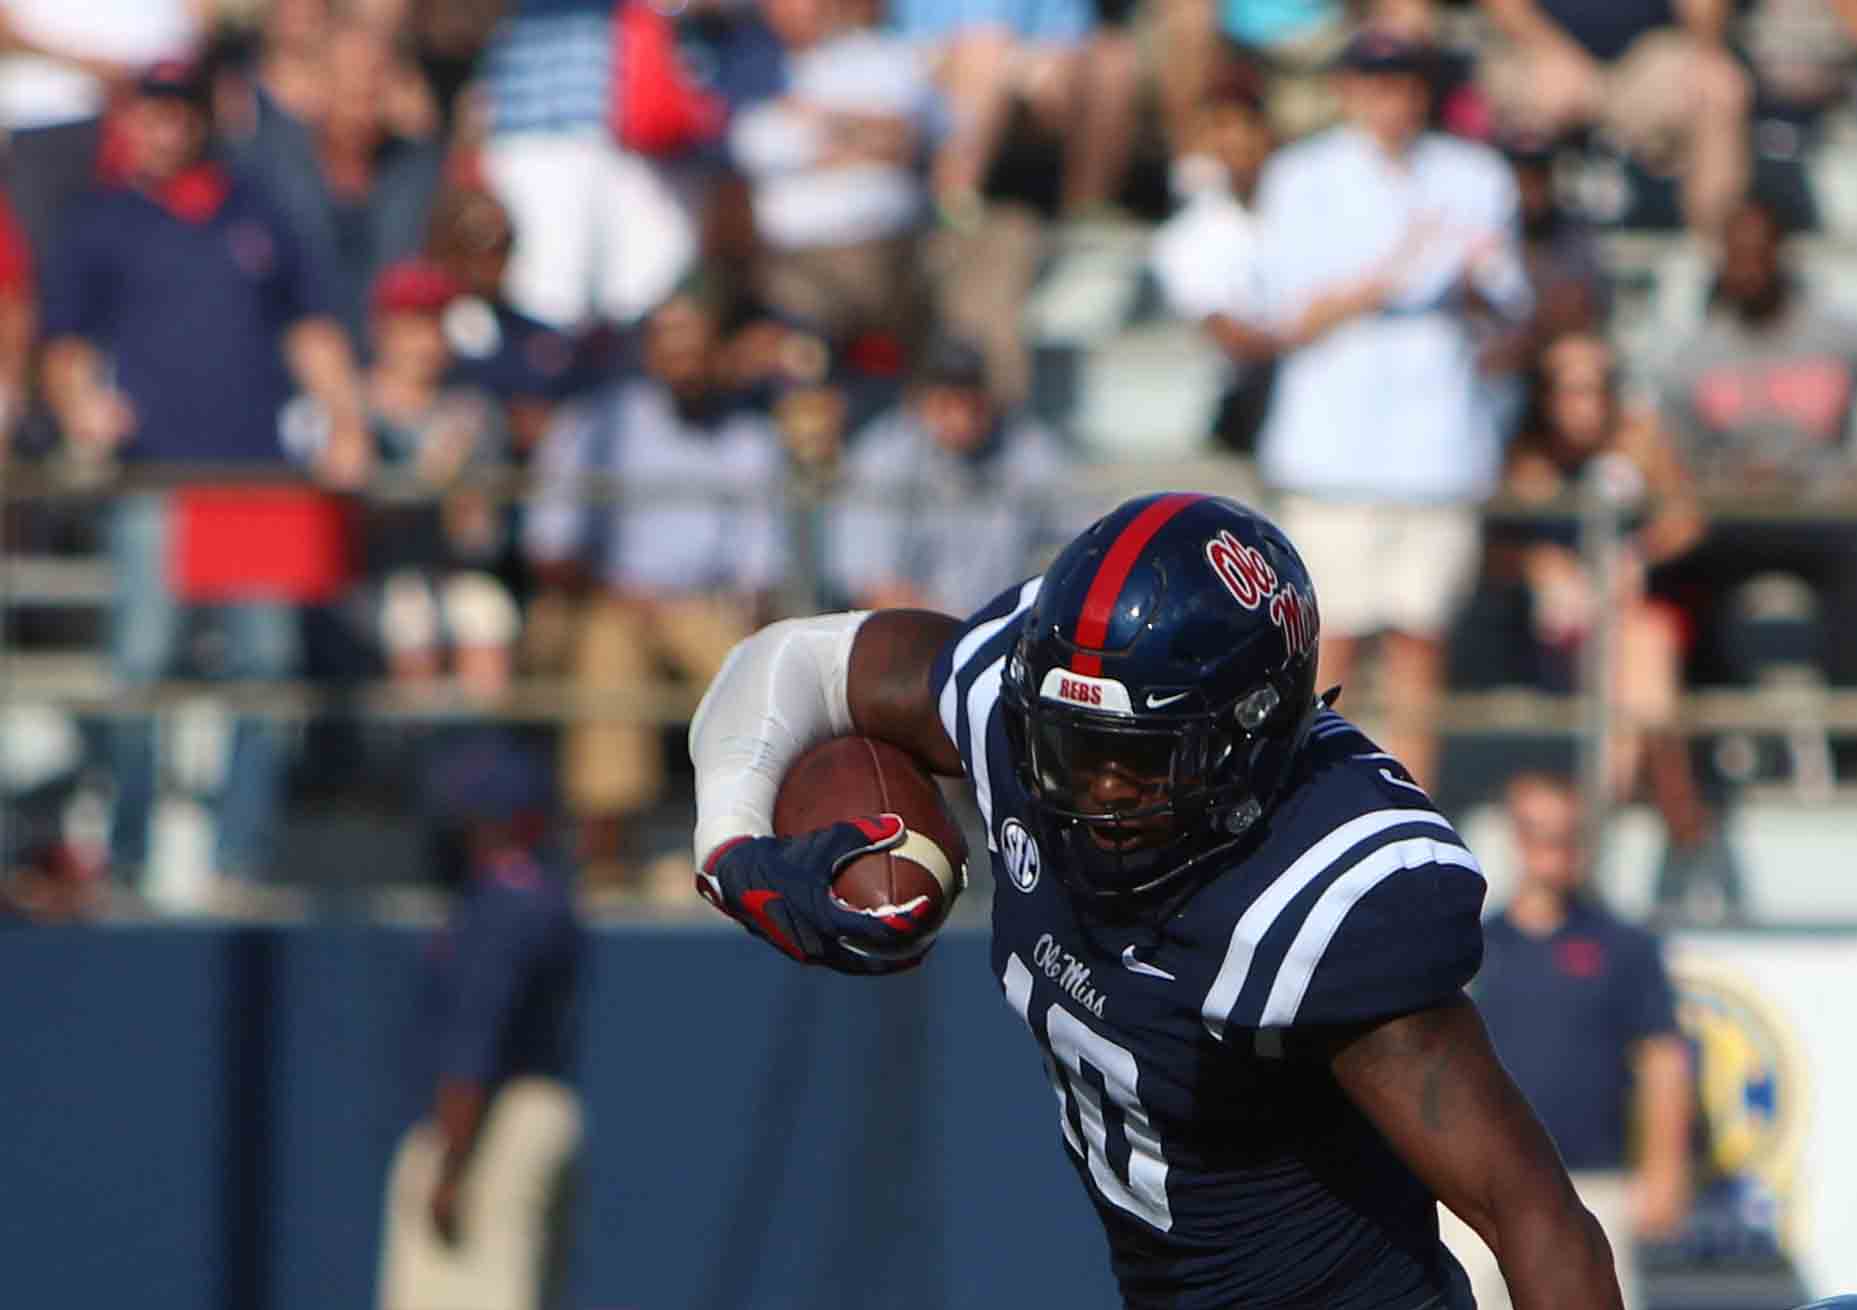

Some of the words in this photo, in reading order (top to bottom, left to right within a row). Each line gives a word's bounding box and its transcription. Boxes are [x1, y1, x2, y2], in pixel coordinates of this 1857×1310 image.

[1206, 529, 1278, 610] Ole
[1059, 678, 1103, 706] REBS
[1033, 932, 1063, 979] Ole
[1060, 953, 1108, 1019] Miss
[1002, 951, 1174, 1233] 10
